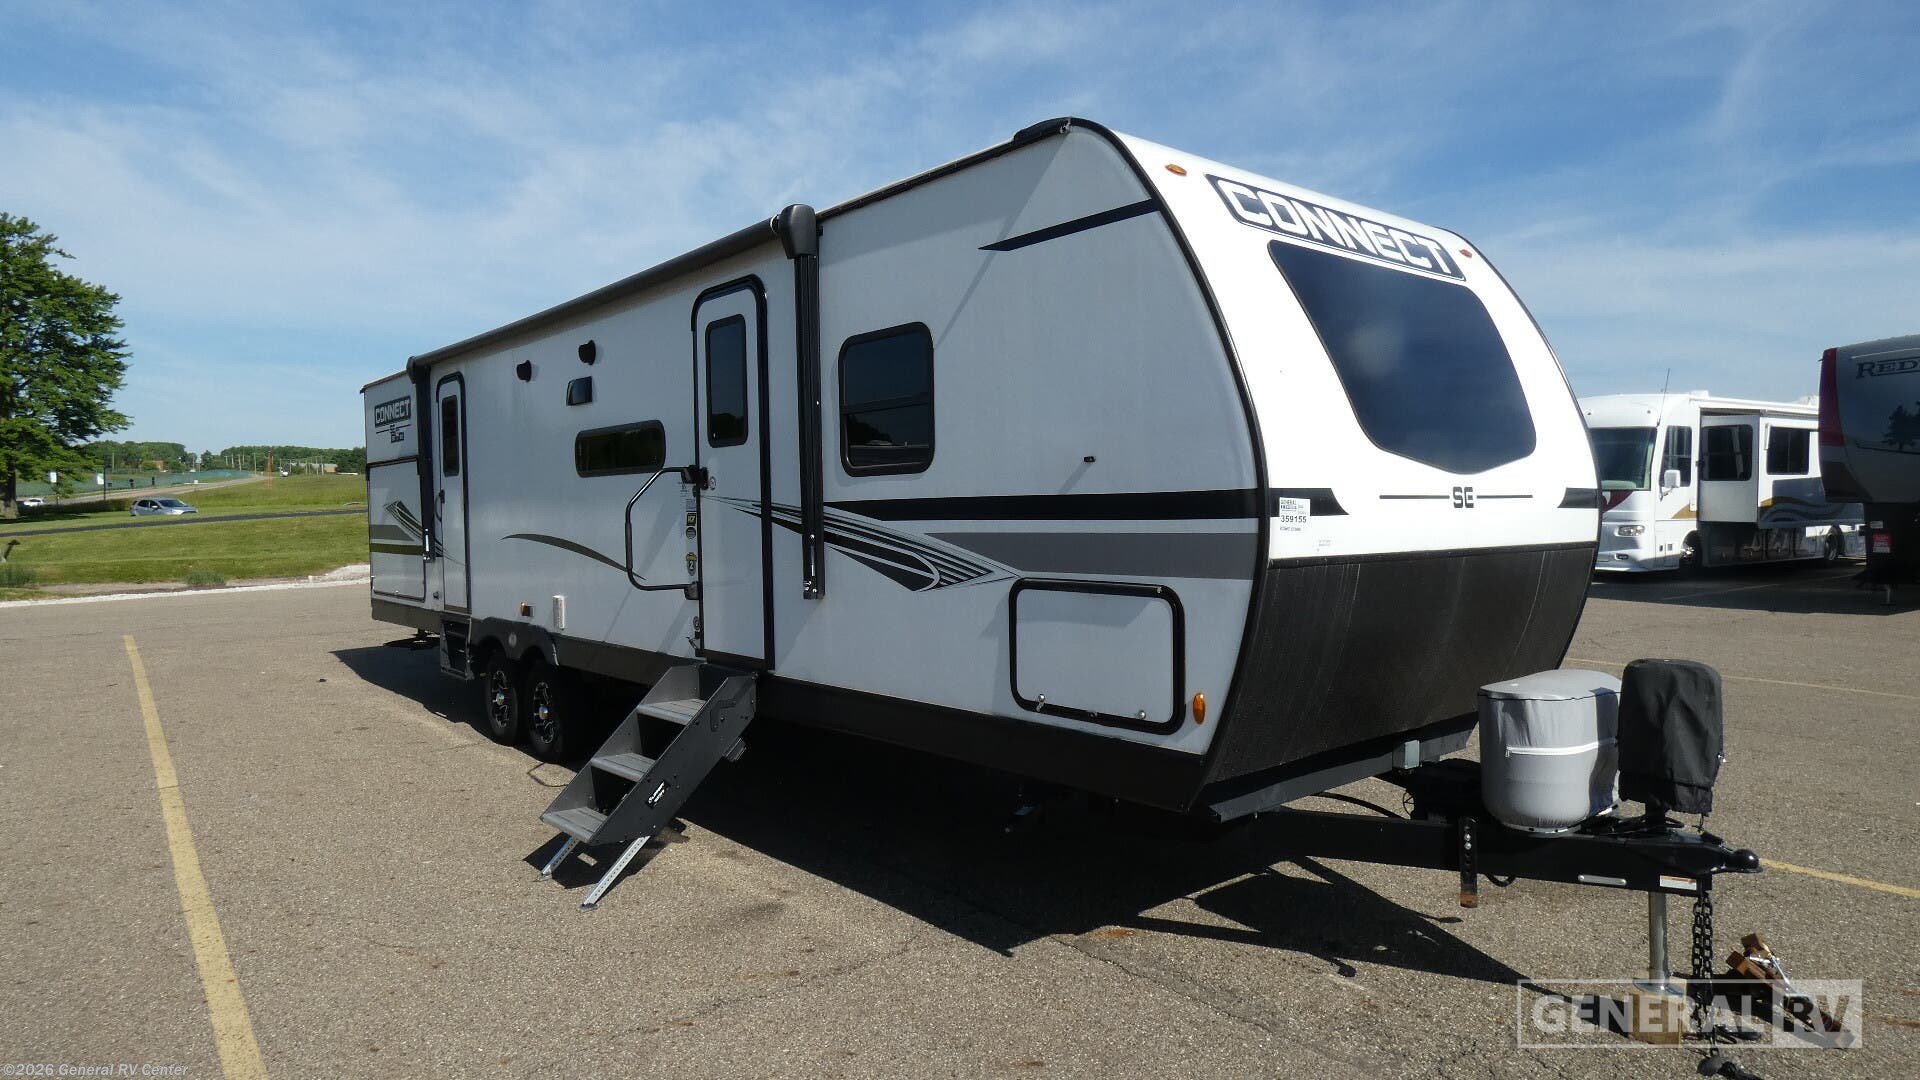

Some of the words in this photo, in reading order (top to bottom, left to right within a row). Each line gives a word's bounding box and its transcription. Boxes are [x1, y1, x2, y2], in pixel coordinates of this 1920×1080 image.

[1217, 180, 1452, 274] CONNECT
[375, 399, 410, 424] CONNECT
[1452, 486, 1474, 508] SE
[1280, 514, 1306, 523] 359155
